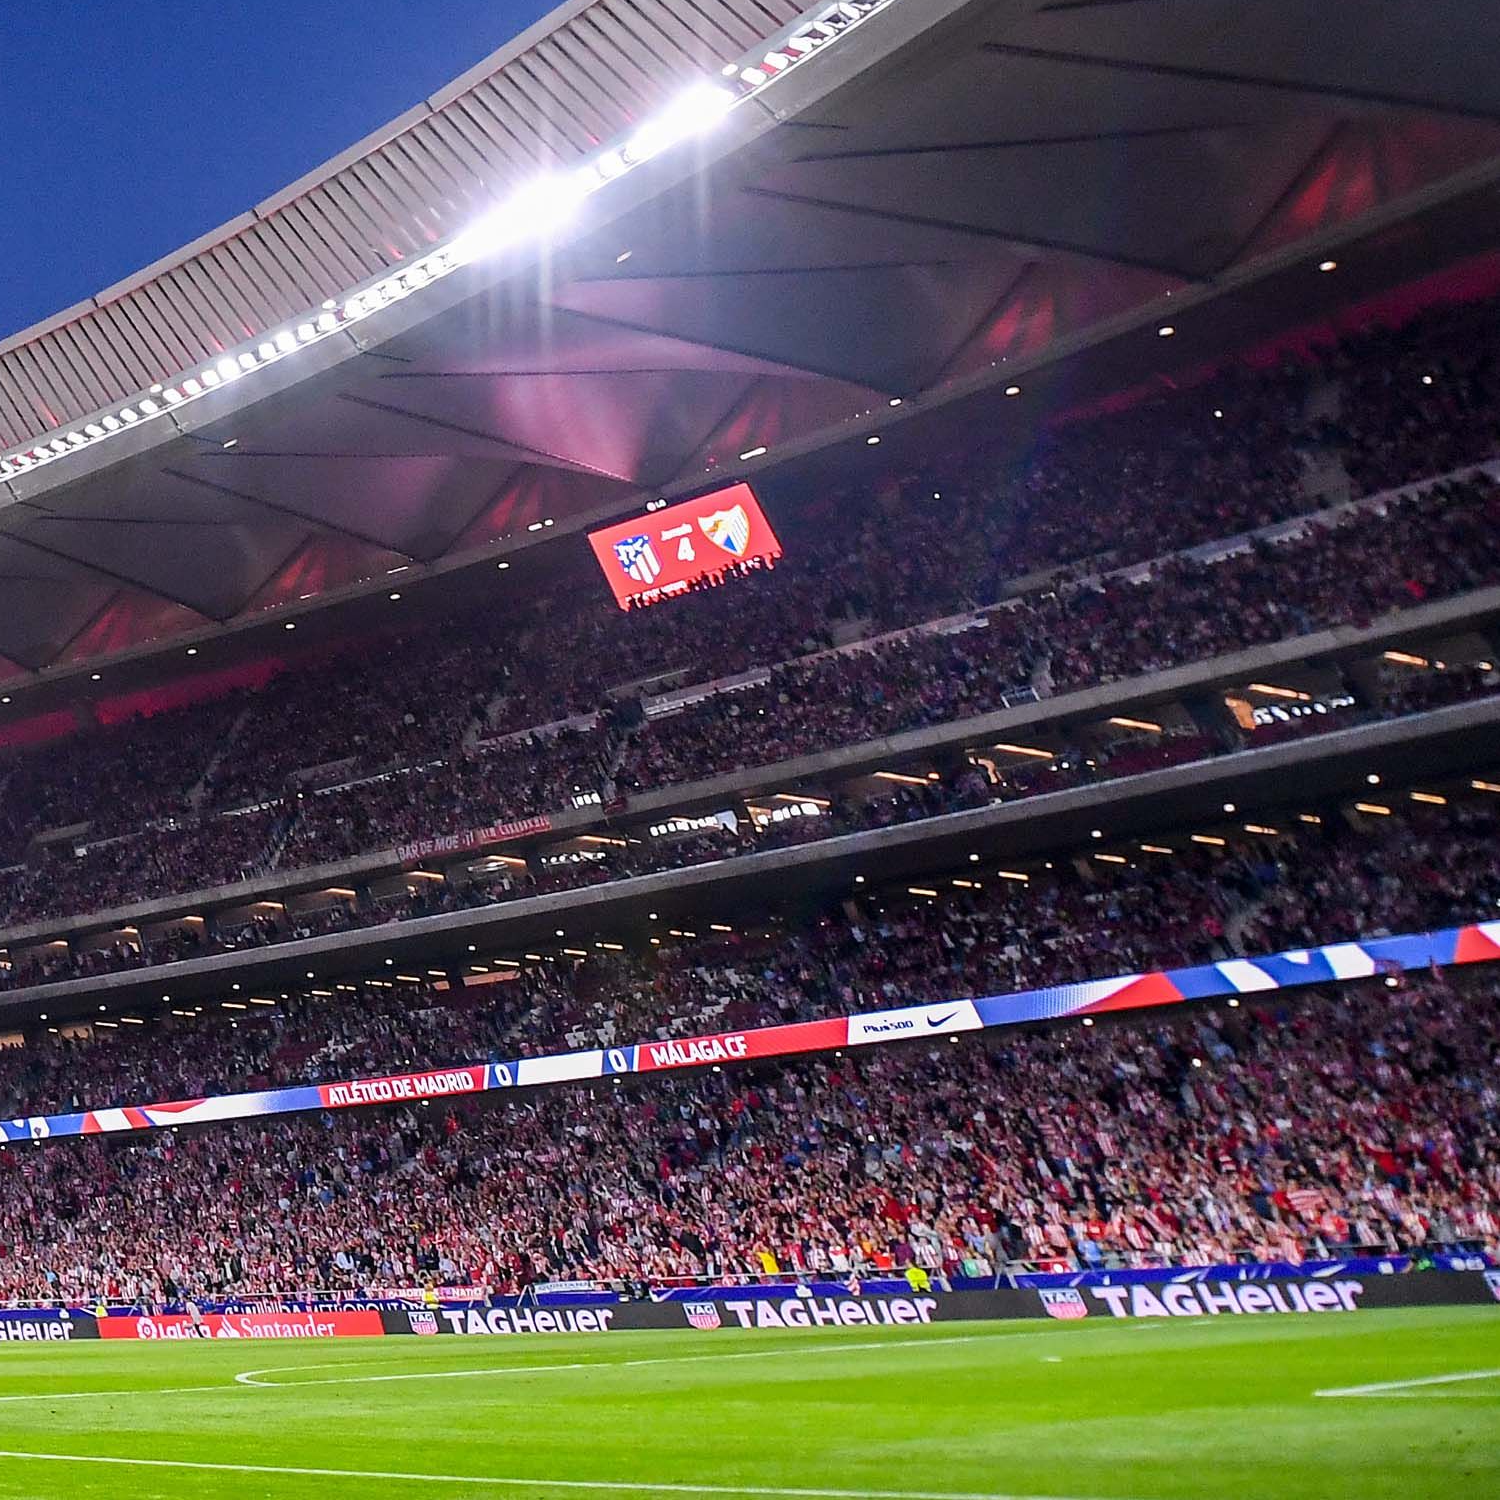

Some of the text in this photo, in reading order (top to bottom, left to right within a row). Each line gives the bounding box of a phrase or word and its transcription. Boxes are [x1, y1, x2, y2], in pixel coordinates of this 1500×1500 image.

[677, 536, 697, 562] 4
[607, 1035, 748, 1073] 0 MÁLAGA CF
[328, 1064, 513, 1106] ATLÉTICO DE MADRID 0
[238, 1315, 336, 1338] Santander
[411, 1313, 433, 1323] TAG
